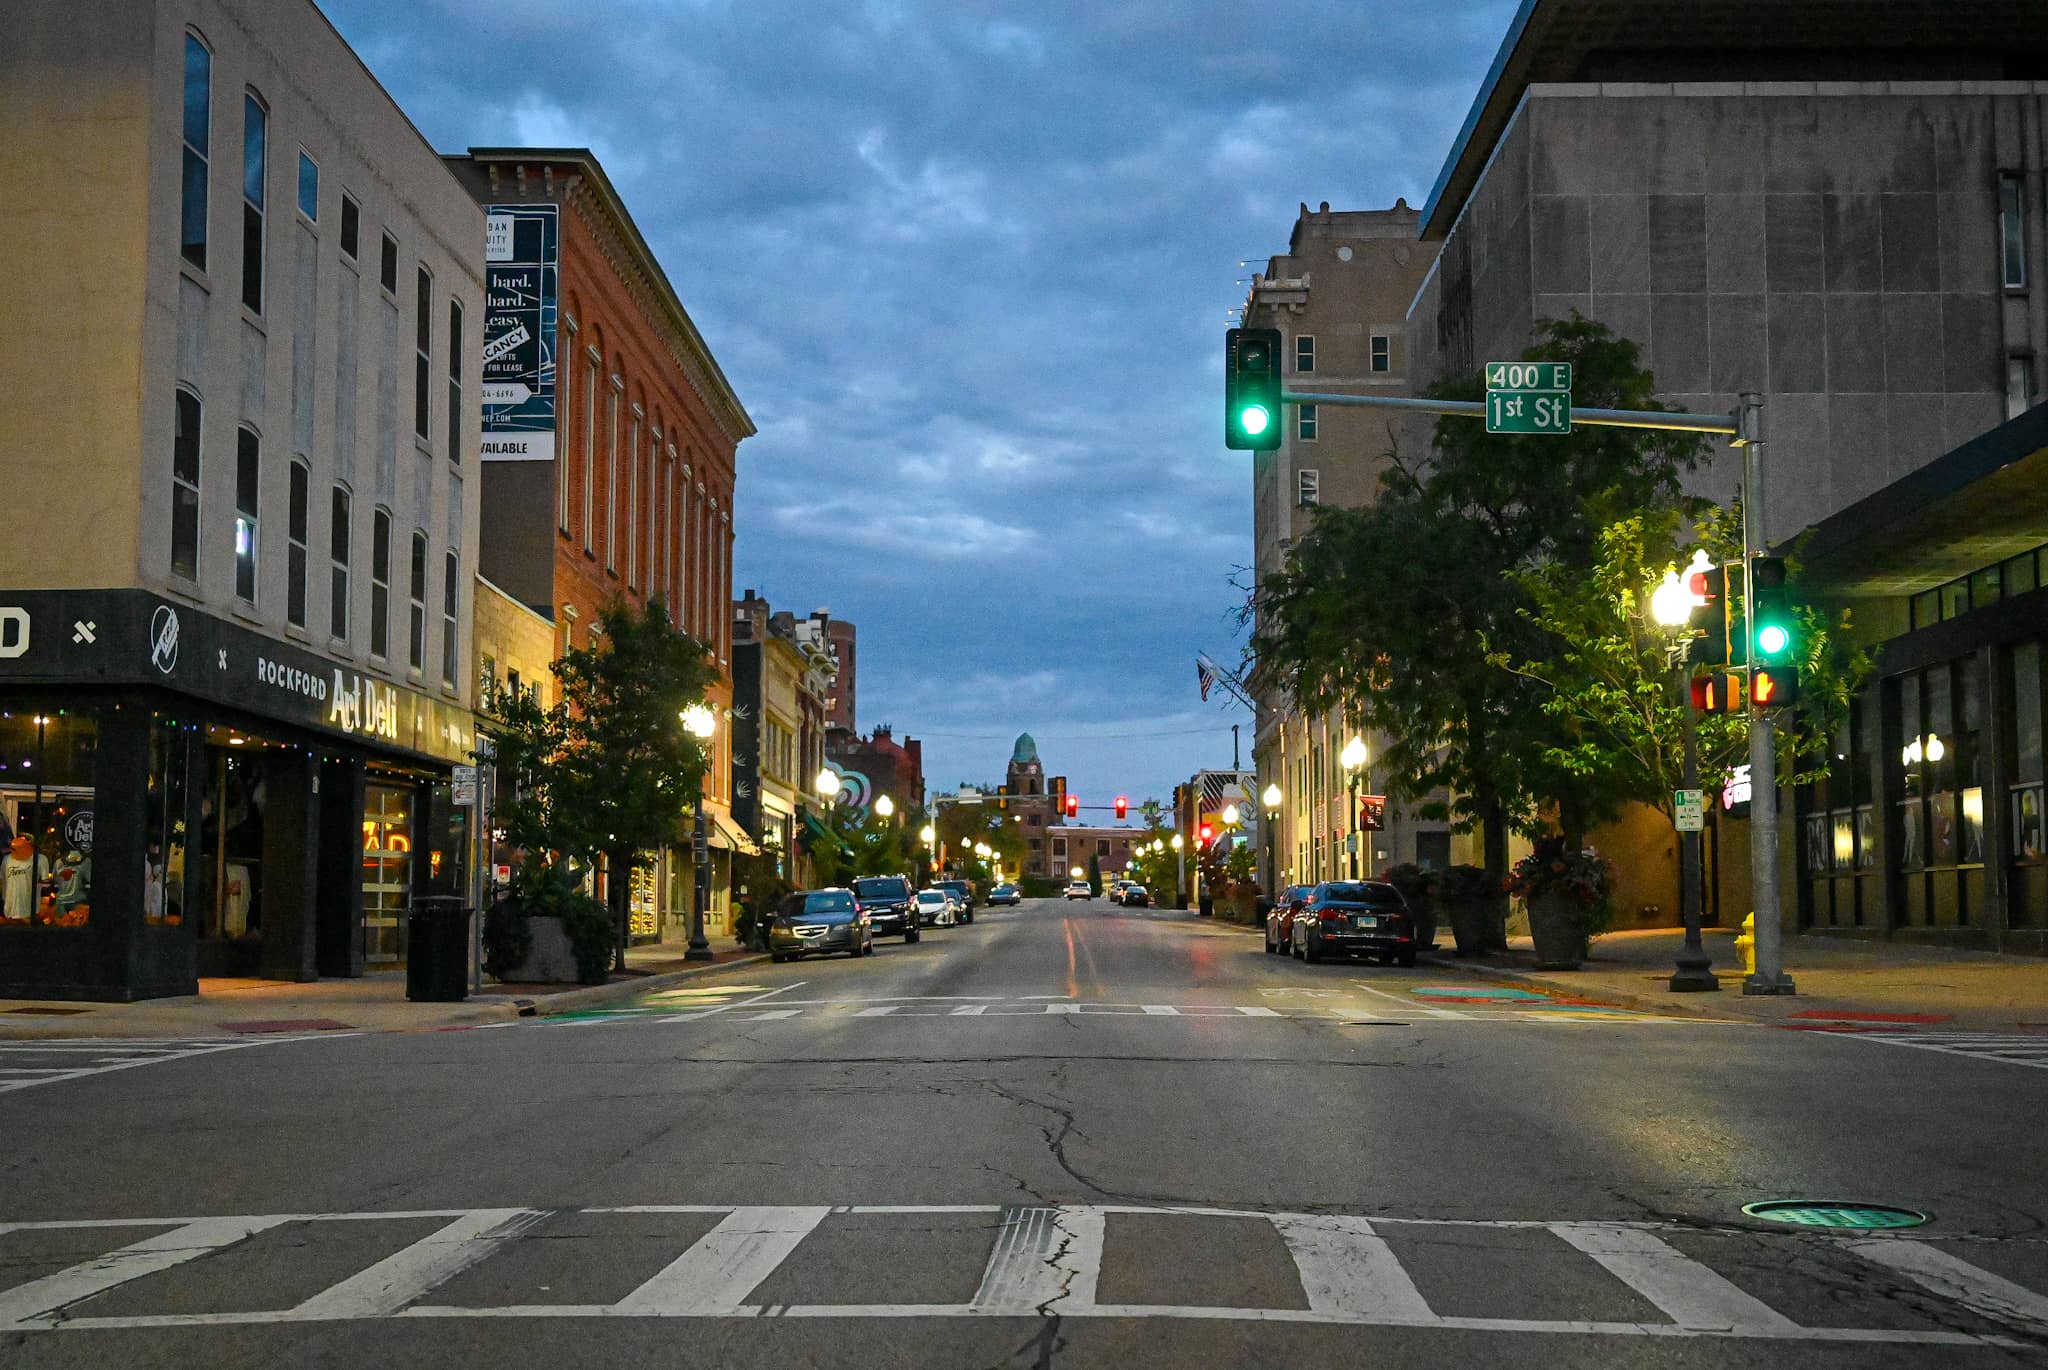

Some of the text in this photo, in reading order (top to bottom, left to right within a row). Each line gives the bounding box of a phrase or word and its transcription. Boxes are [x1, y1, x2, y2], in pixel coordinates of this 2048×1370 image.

[493, 274, 532, 288] hard.
[487, 293, 526, 307] hard.
[483, 330, 524, 360] CANCY
[503, 364, 523, 372] LEASE
[1492, 365, 1565, 388] 400 E
[1494, 396, 1563, 428] 1st St
[258, 656, 398, 739] ROCKFORD Art Deli
